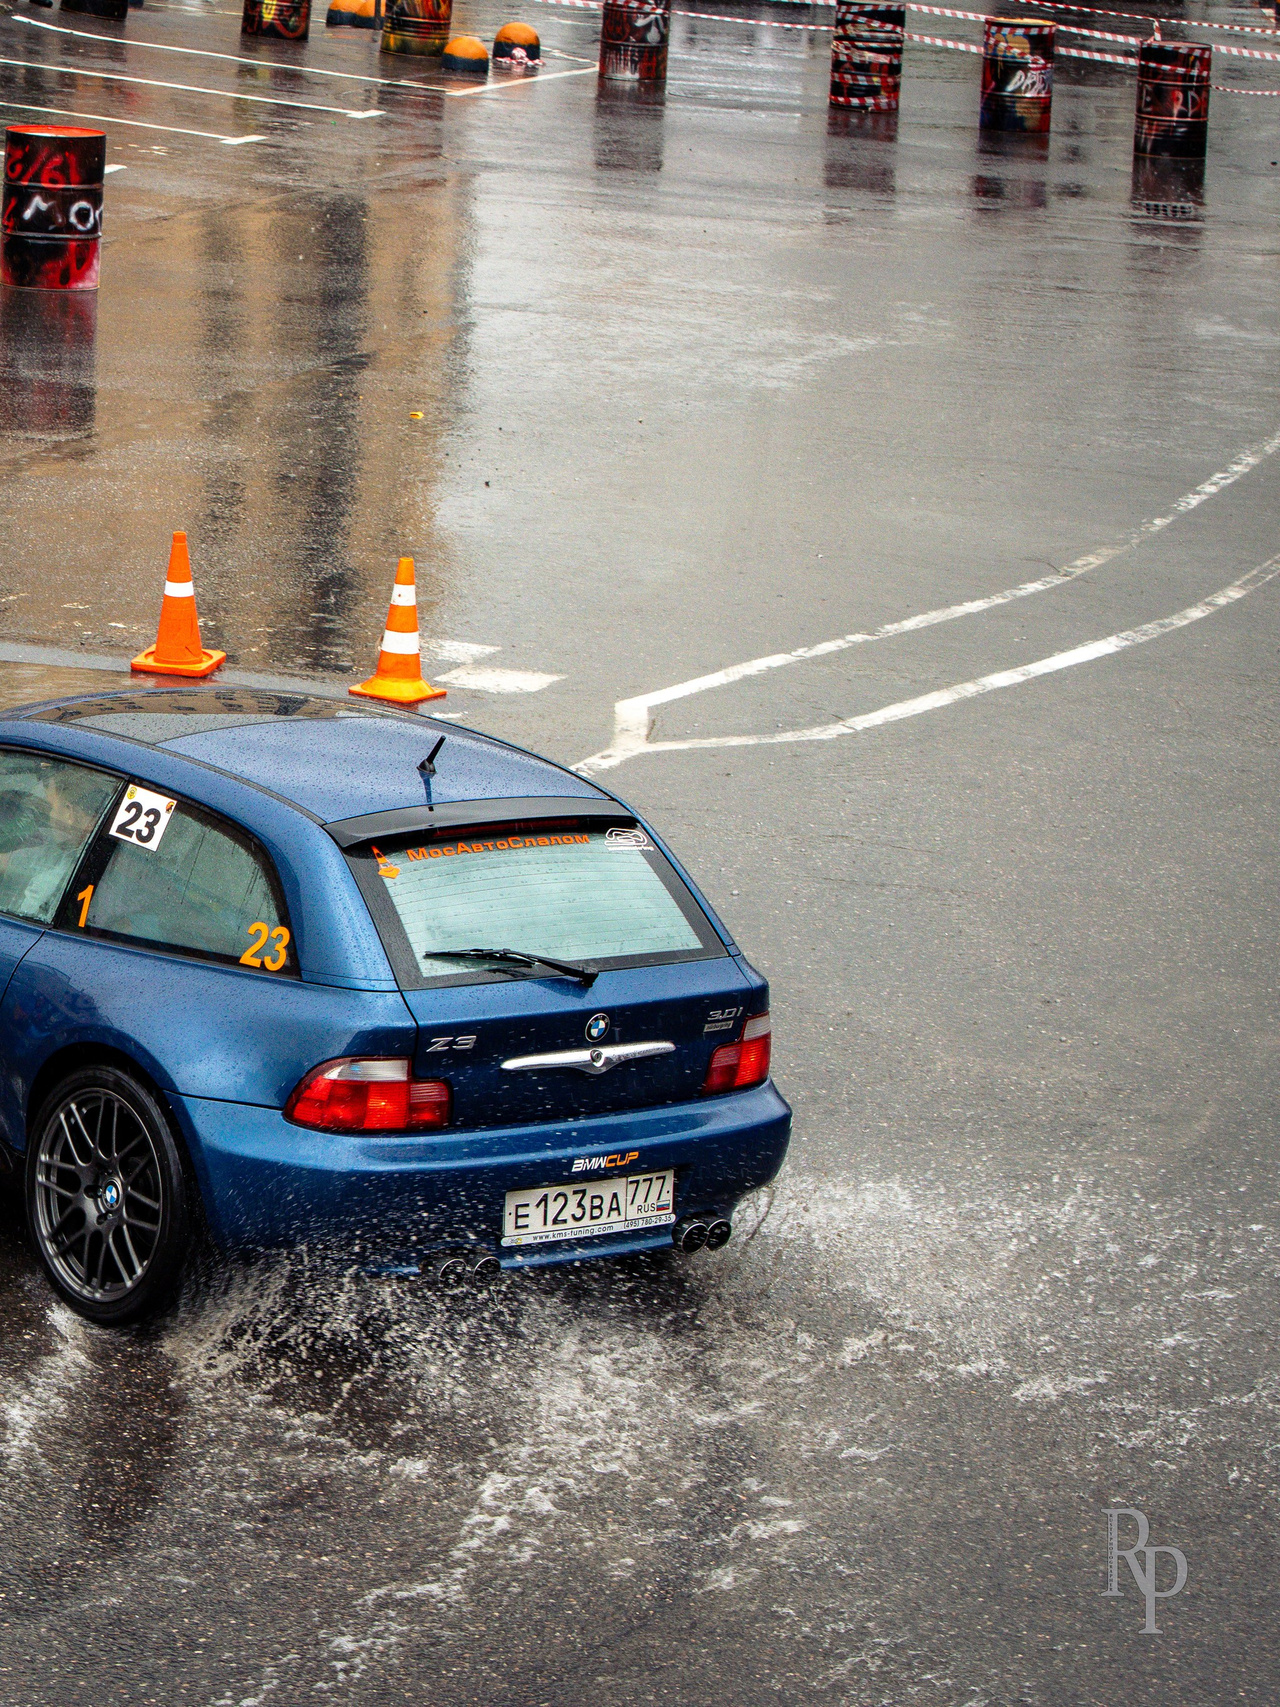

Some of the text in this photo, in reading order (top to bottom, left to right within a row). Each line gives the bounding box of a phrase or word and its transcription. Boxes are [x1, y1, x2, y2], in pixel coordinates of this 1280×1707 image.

[115, 801, 162, 844] 23
[405, 833, 591, 862] МосАвтоСлалом
[77, 884, 95, 928] 1
[239, 921, 291, 972] 23
[425, 1035, 477, 1052] Z3
[628, 1175, 667, 1205] 777
[636, 1202, 656, 1214] RUS
[532, 1224, 614, 1241] www.kms-tuning.com
[623, 1220, 640, 1229] (495)
[641, 1214, 672, 1226] 780-29-35
